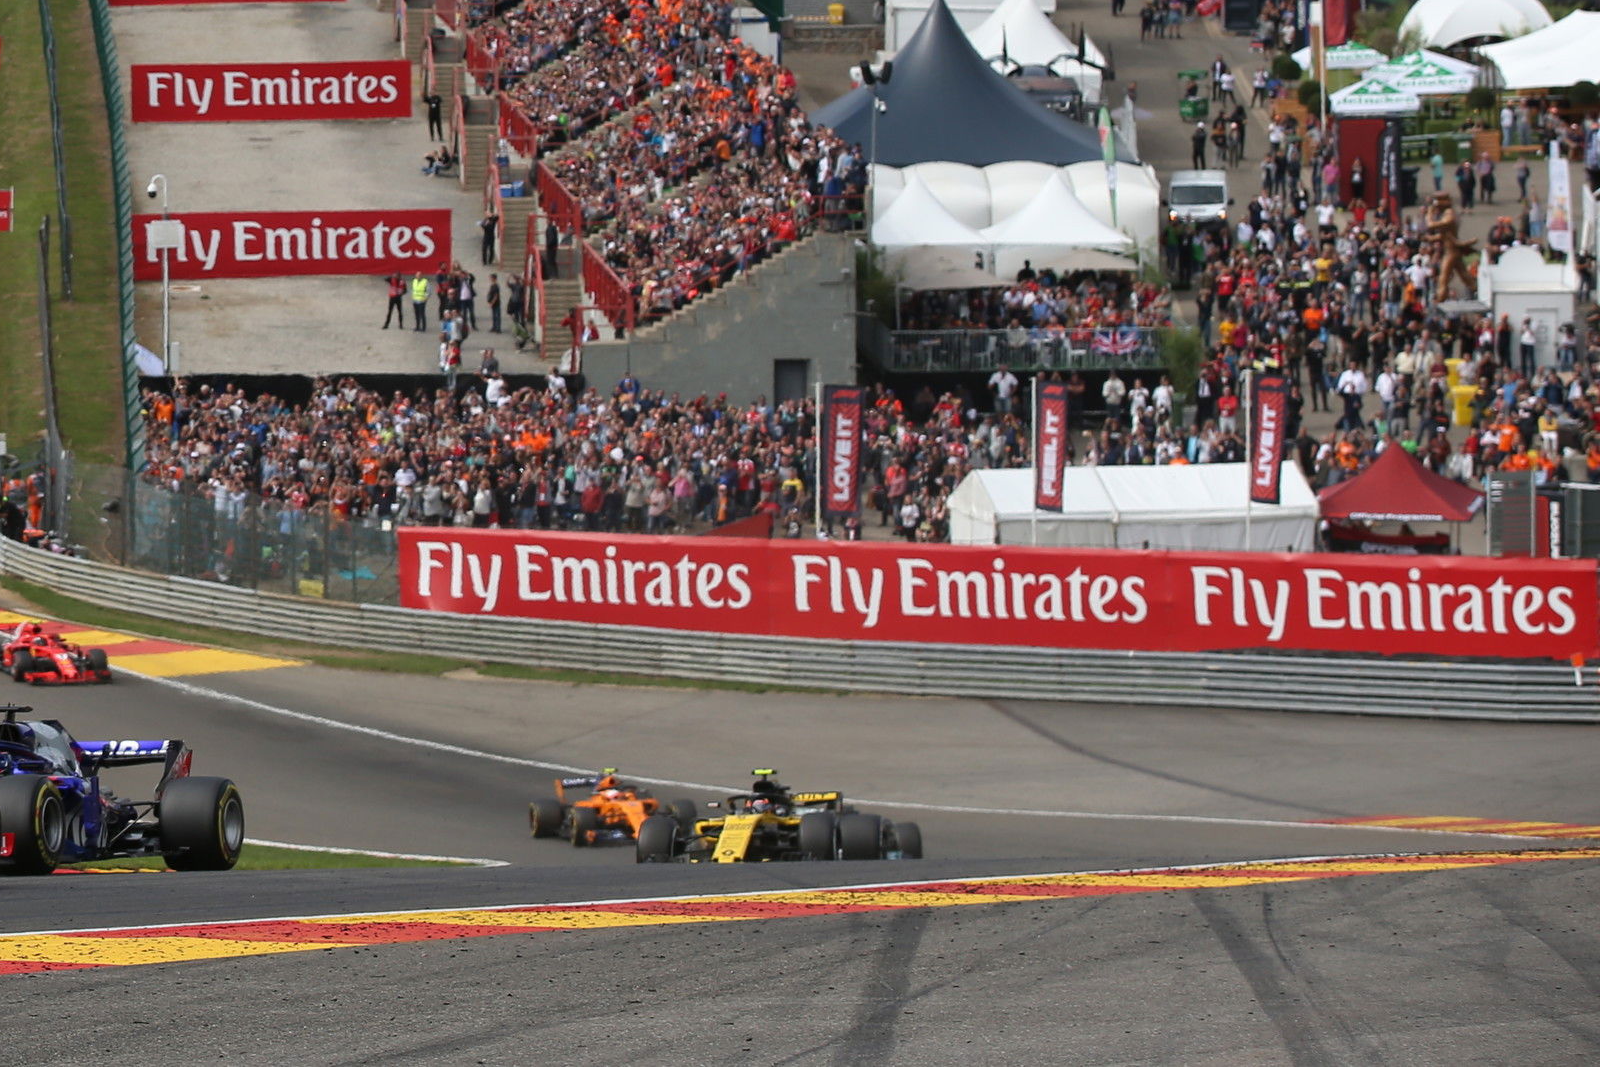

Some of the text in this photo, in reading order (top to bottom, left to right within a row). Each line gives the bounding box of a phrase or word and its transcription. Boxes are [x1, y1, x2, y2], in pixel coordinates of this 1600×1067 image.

[147, 69, 398, 114] Fly Emirates
[232, 217, 436, 262] Emirates
[832, 413, 853, 502] LOVE IT
[416, 541, 753, 612] Fly Emirates
[791, 554, 1148, 628] Fly Emirates
[1191, 565, 1577, 642] Fly Emirates
